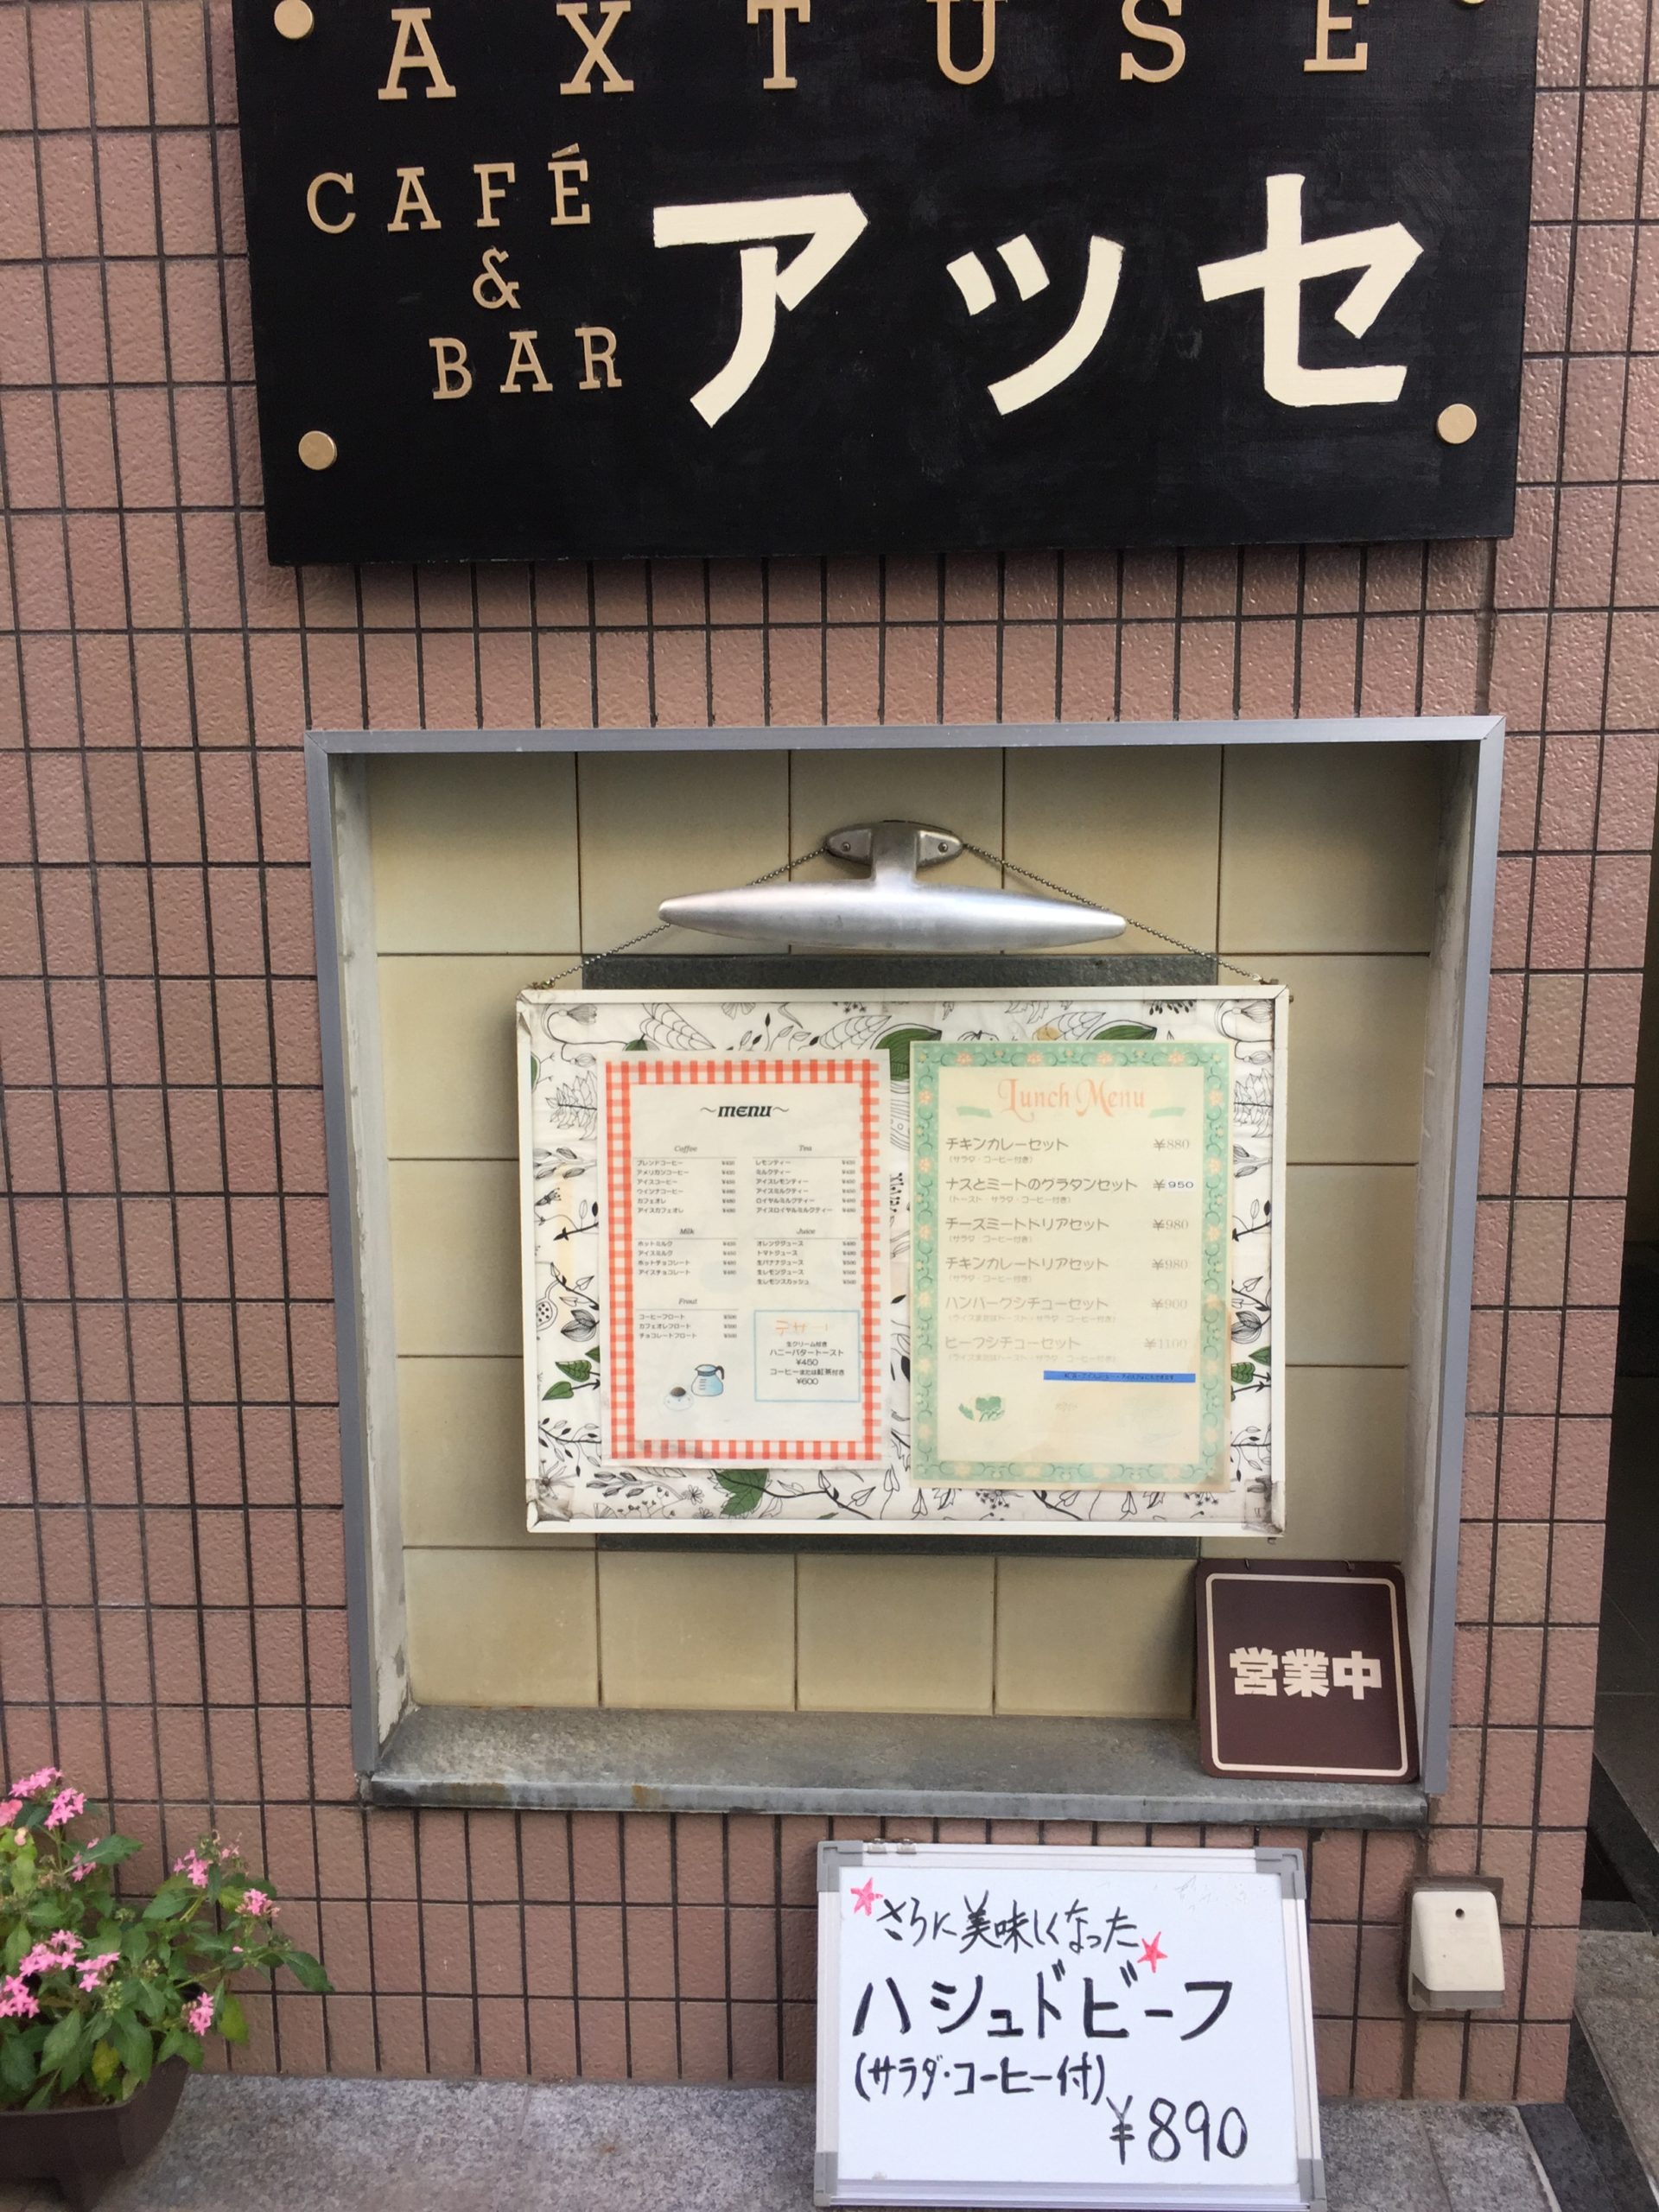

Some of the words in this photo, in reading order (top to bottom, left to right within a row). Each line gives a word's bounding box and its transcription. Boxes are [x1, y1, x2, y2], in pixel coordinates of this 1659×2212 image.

[378, 0, 1369, 99] AXTUSE
[306, 143, 591, 234] CAFÉ
[472, 246, 521, 310] &
[653, 173, 1425, 429] アッセ
[429, 326, 622, 400] BAR
[998, 1078, 1071, 1122] Lunch
[1076, 1078, 1147, 1117] Menu
[946, 1137, 1070, 1151] チキンカレーセット
[1153, 1137, 1190, 1151] ¥880
[946, 1177, 1138, 1192] ナスとミートのグラタンセット
[1153, 1177, 1194, 1192] ¥950
[1152, 1217, 1189, 1231] ¥980
[1152, 1257, 1188, 1271] ¥980
[1229, 1646, 1383, 1700] 営業中
[876, 1890, 1141, 1955] さらに美味しくなった
[852, 1958, 1234, 2042] ハシュドビーフ
[1106, 2094, 1249, 2166] ¥890
